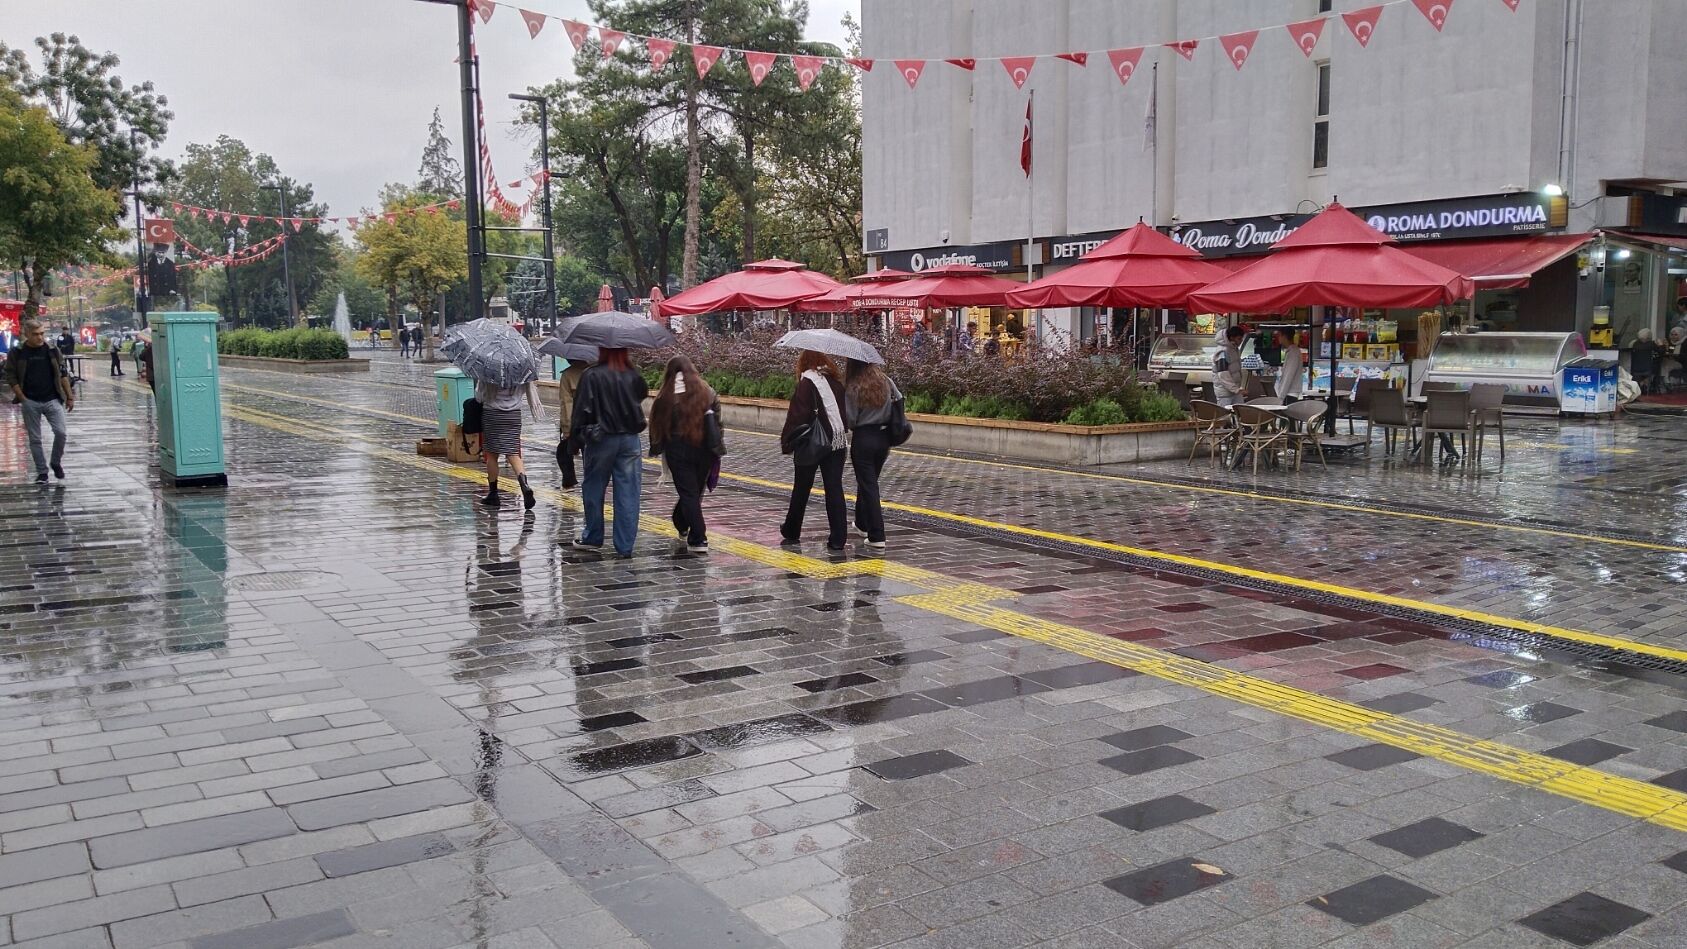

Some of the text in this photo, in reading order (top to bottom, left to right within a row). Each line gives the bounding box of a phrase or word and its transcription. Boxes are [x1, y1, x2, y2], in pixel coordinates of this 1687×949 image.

[1387, 204, 1547, 233] ROMA DONDURMA
[1182, 228, 1233, 252] Roma
[926, 252, 977, 269] vodafone
